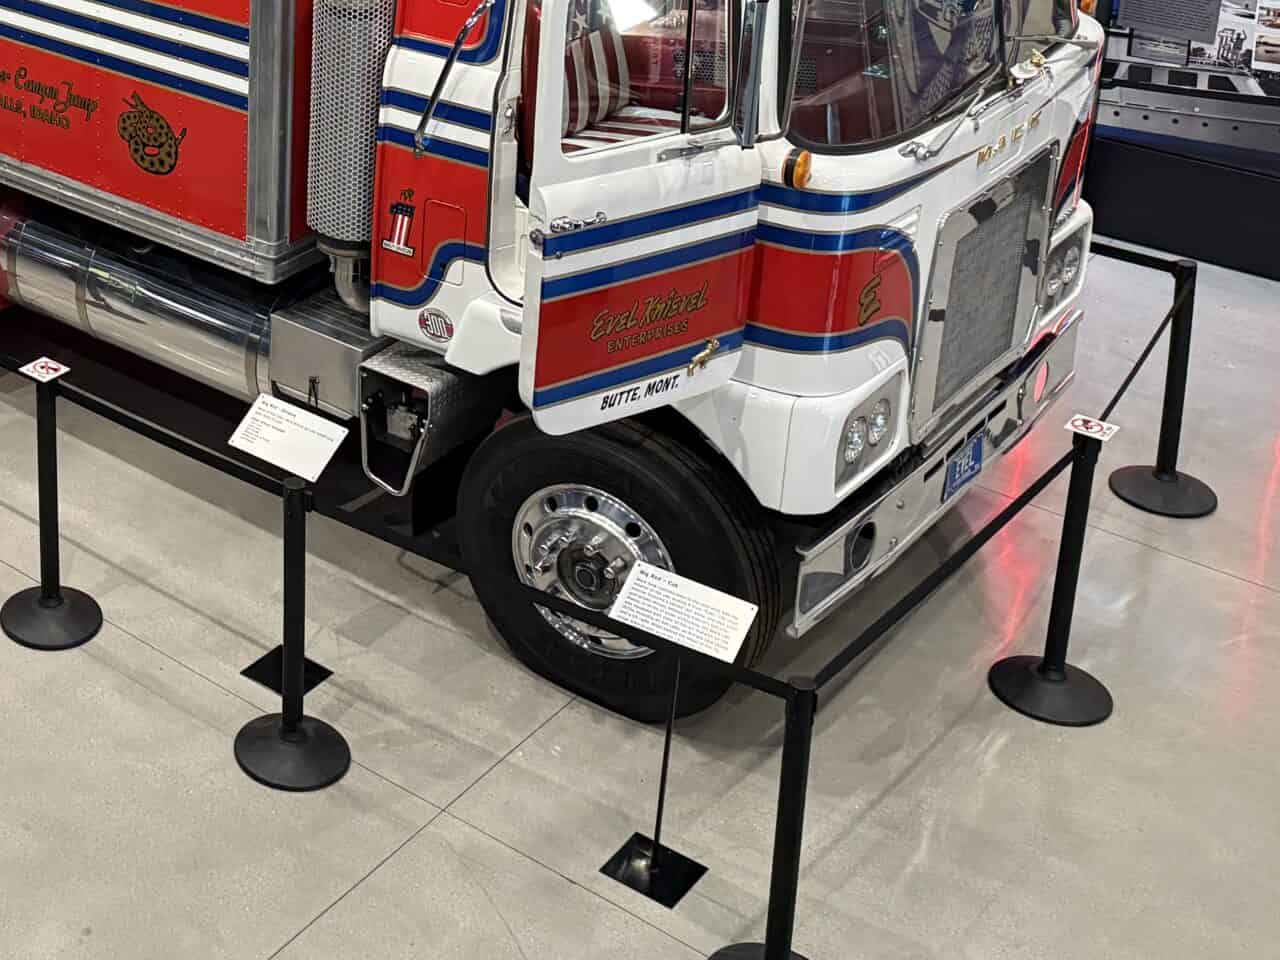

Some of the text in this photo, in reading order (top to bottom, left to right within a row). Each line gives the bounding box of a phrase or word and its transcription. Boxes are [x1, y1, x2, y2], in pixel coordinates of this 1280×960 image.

[424, 311, 449, 338] 300
[607, 320, 689, 353] ENTERPRISES
[643, 375, 680, 398] MONT.
